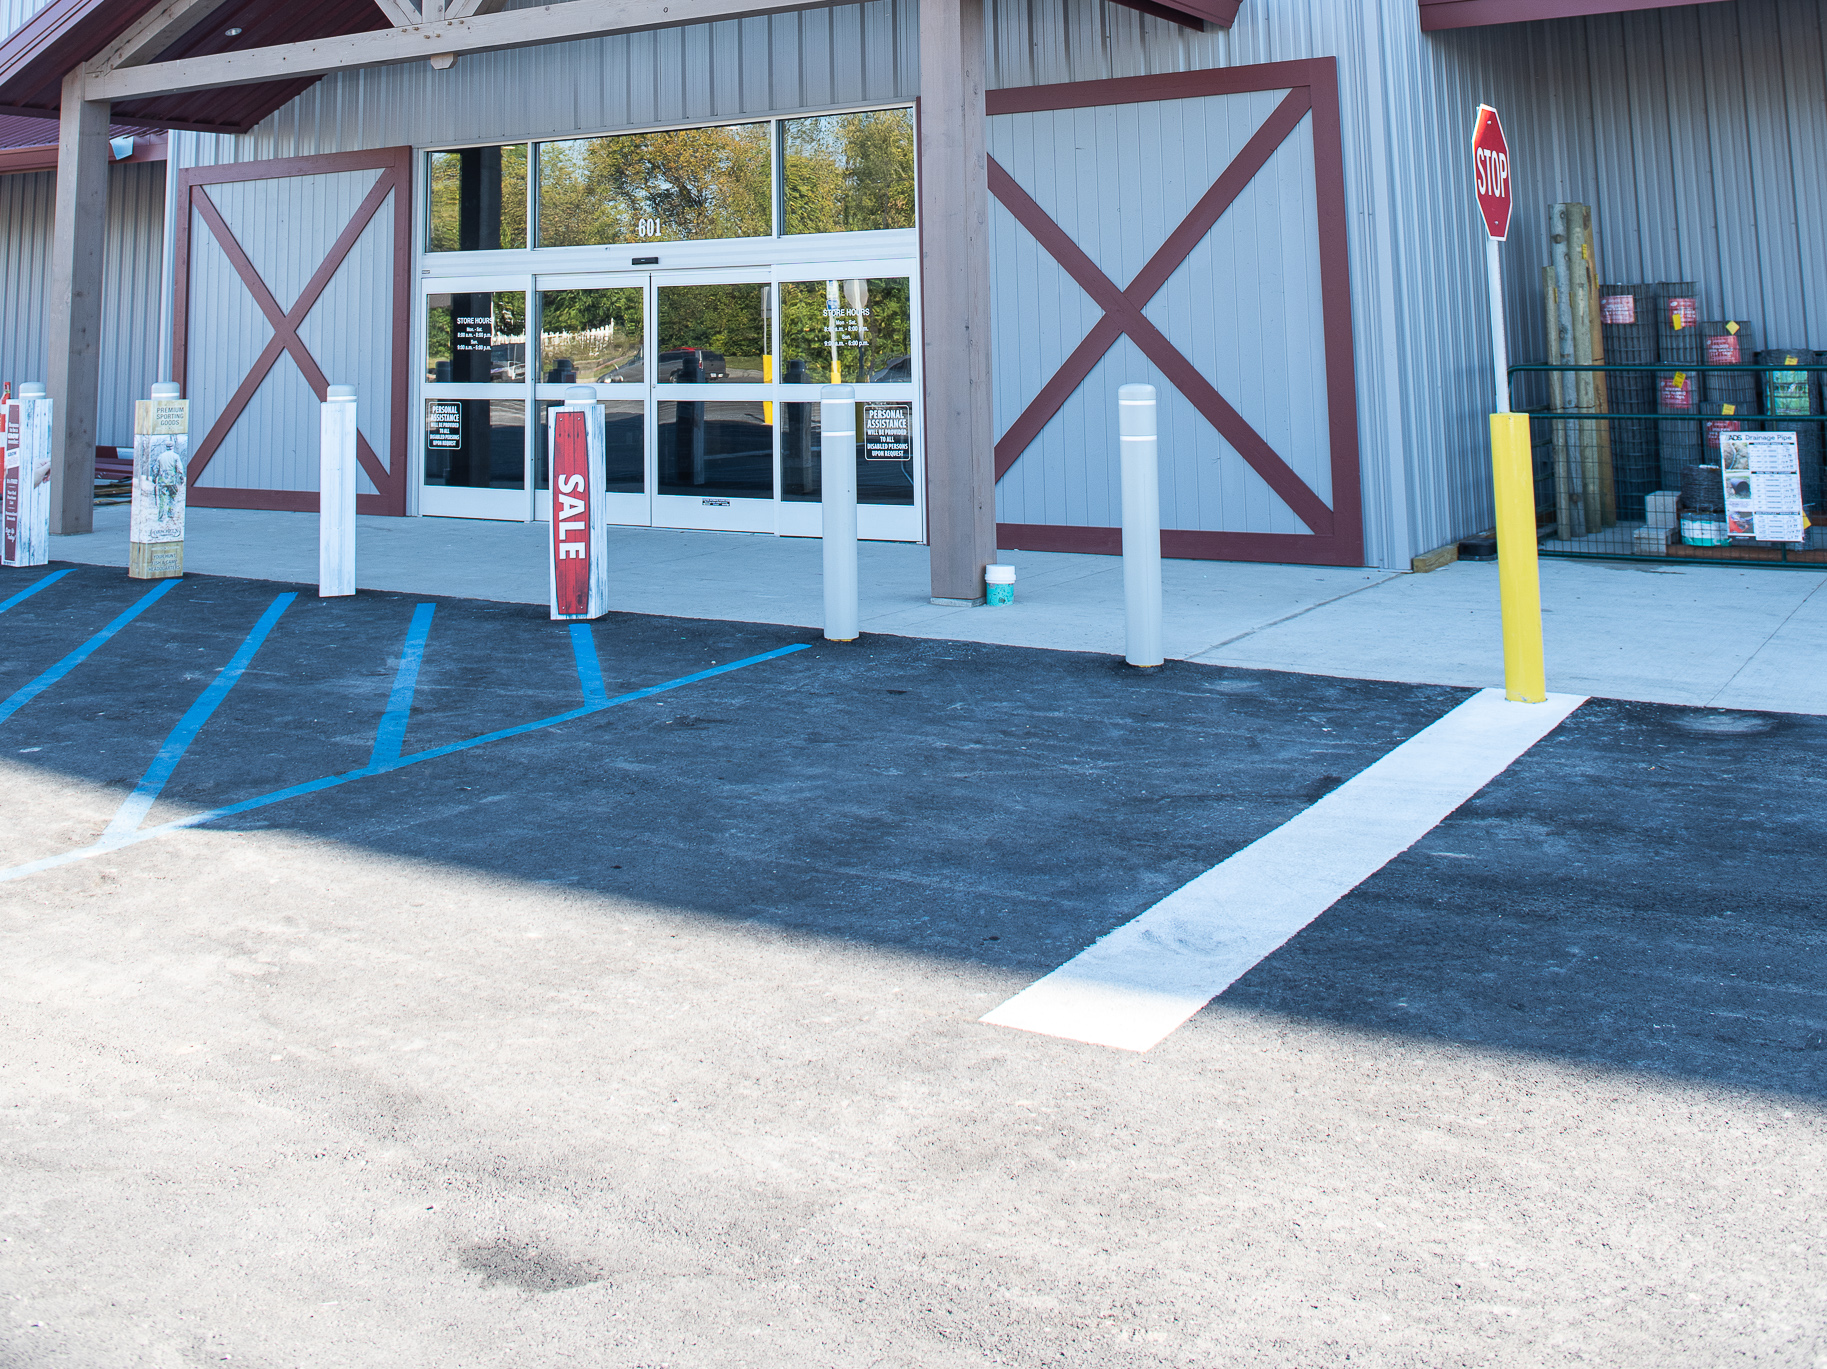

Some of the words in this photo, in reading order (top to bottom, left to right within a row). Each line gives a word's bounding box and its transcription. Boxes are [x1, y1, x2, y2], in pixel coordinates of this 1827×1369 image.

[1477, 147, 1507, 198] STOP
[639, 218, 661, 237] 601
[823, 308, 845, 317] STORE
[846, 308, 870, 316] HOURS
[869, 410, 904, 419] PERSONAL
[867, 419, 907, 428] ASSISTANCE
[558, 474, 586, 560] SALE
